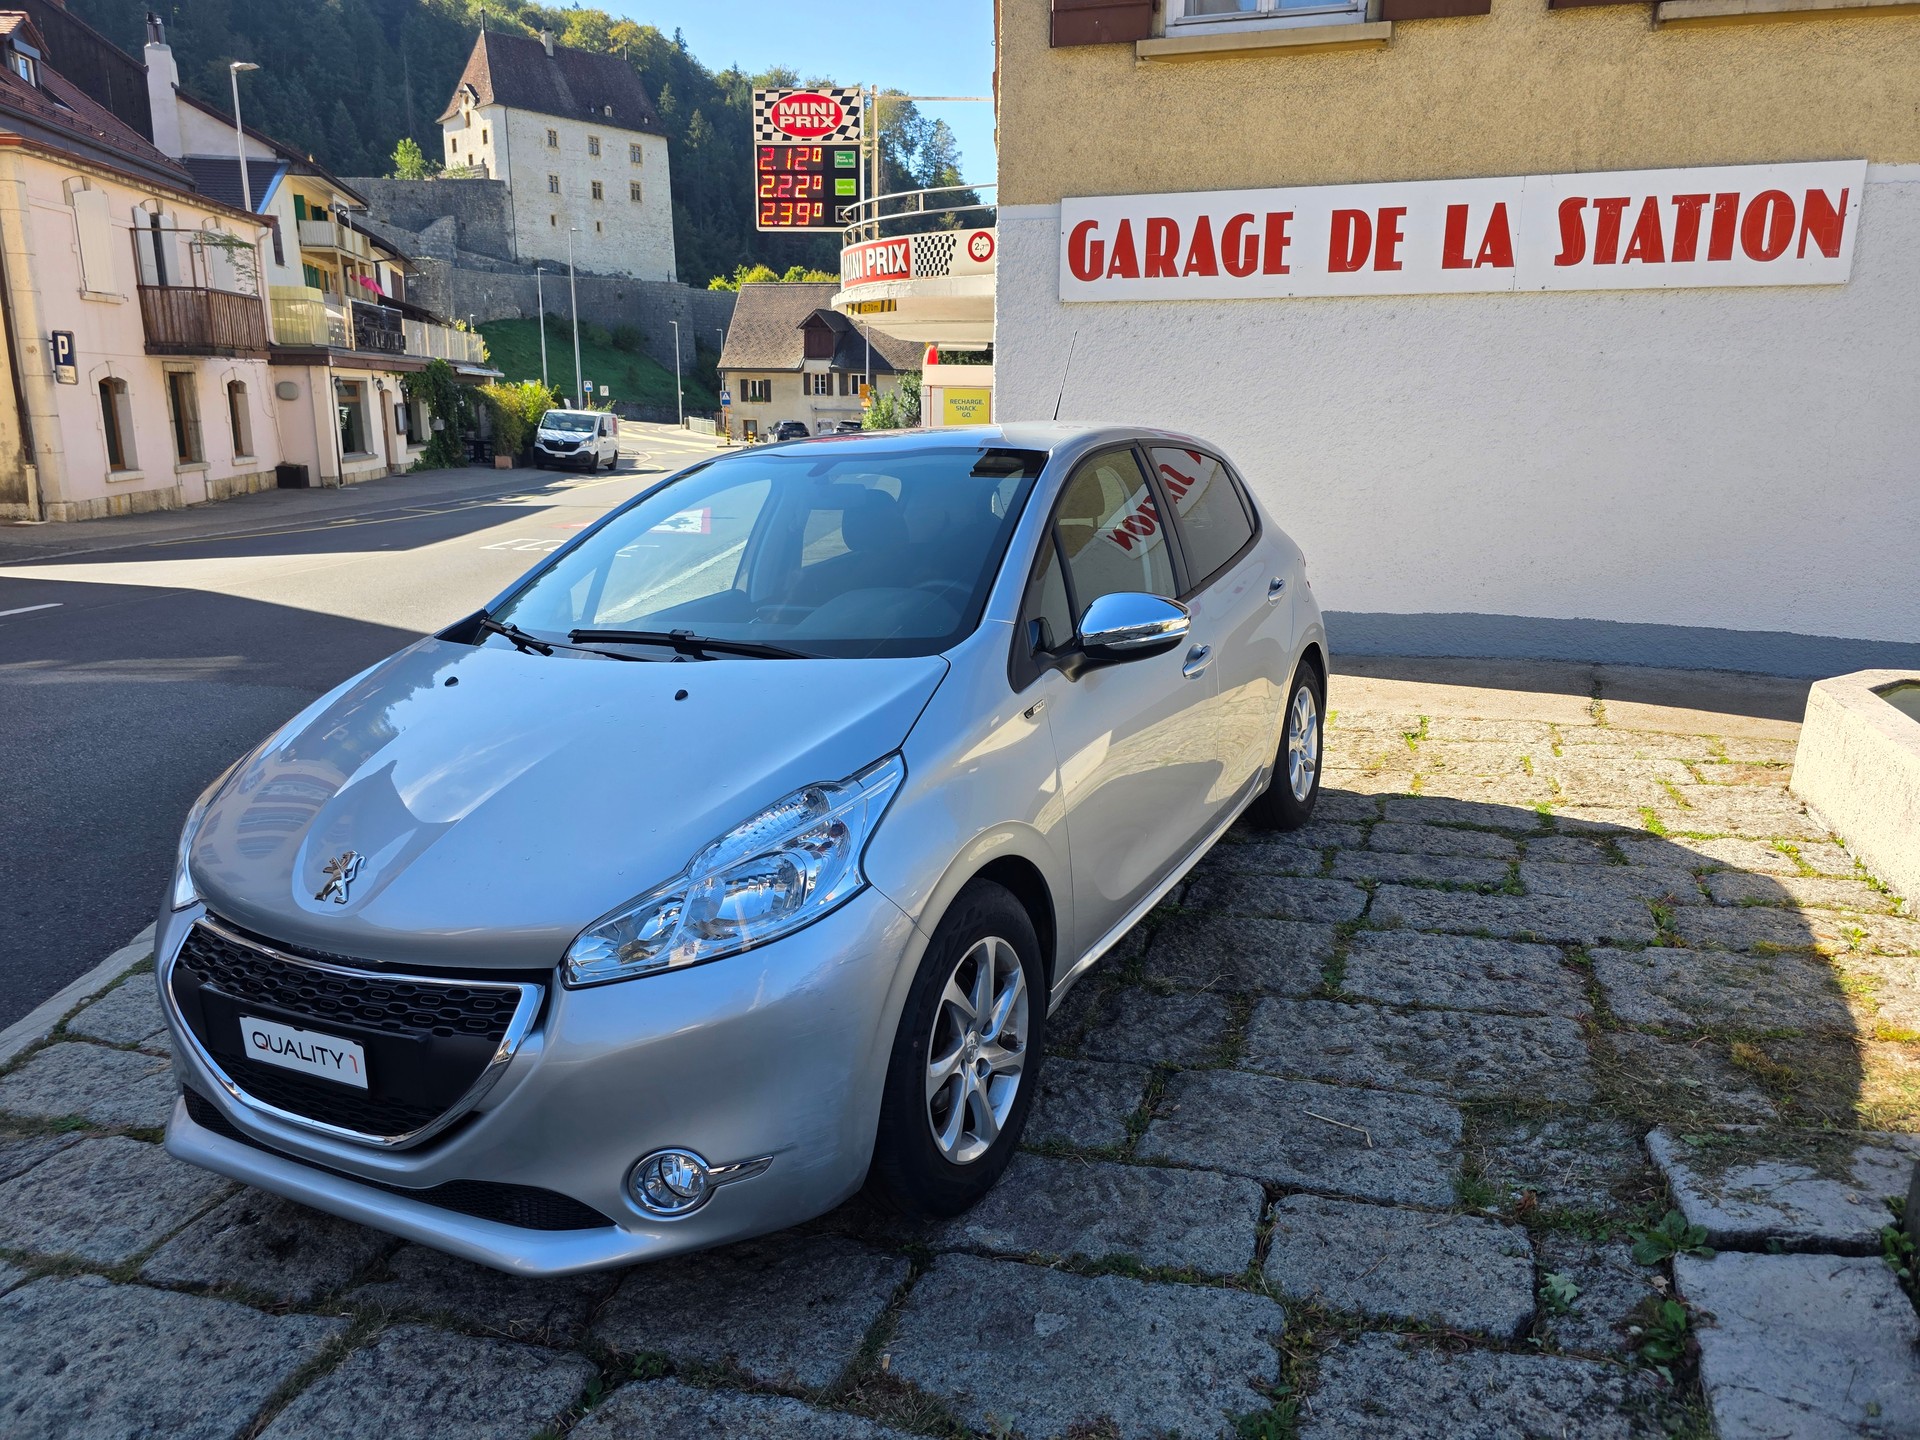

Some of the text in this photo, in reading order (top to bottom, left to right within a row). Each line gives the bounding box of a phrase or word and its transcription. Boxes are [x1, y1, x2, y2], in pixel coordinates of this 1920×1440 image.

[778, 102, 836, 116] MINI
[778, 115, 837, 129] PRIX
[1067, 187, 1850, 282] GARAGE DE LA STATION
[844, 243, 908, 283] MINI PRIX
[57, 335, 69, 364] P
[252, 1031, 343, 1069] QUALITY
